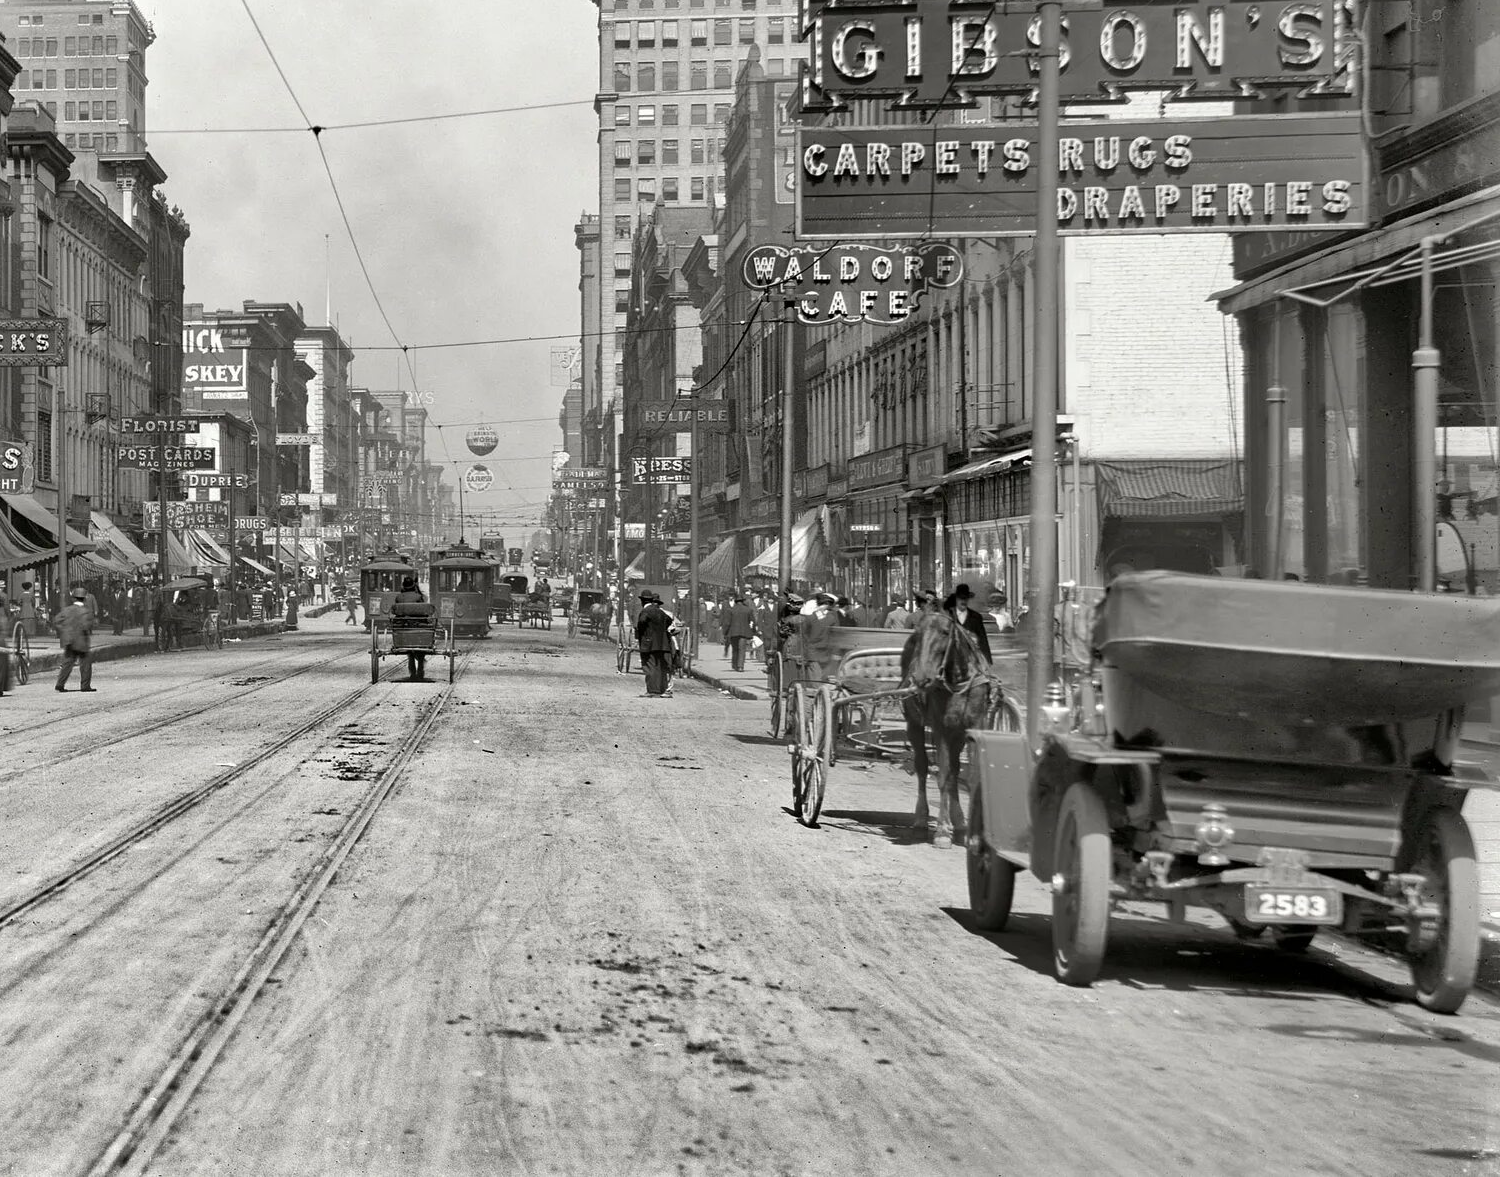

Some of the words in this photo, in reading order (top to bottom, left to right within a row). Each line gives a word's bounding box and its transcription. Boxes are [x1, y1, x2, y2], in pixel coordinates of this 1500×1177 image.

[831, 2, 1325, 79] GIBSON'S
[803, 139, 1031, 176] CARPETS
[1059, 135, 1193, 171] RUGS
[1056, 180, 1351, 220] DRAPERIES
[753, 255, 955, 281] WALDORF
[800, 290, 909, 315] CAFE
[185, 364, 242, 382] SKEY
[121, 418, 198, 432] FLORIST
[645, 410, 727, 422] RELIABLE
[118, 448, 157, 461] POST
[164, 448, 213, 462] CARDS
[235, 518, 267, 529] DRUGS
[1259, 893, 1327, 918] 2583
